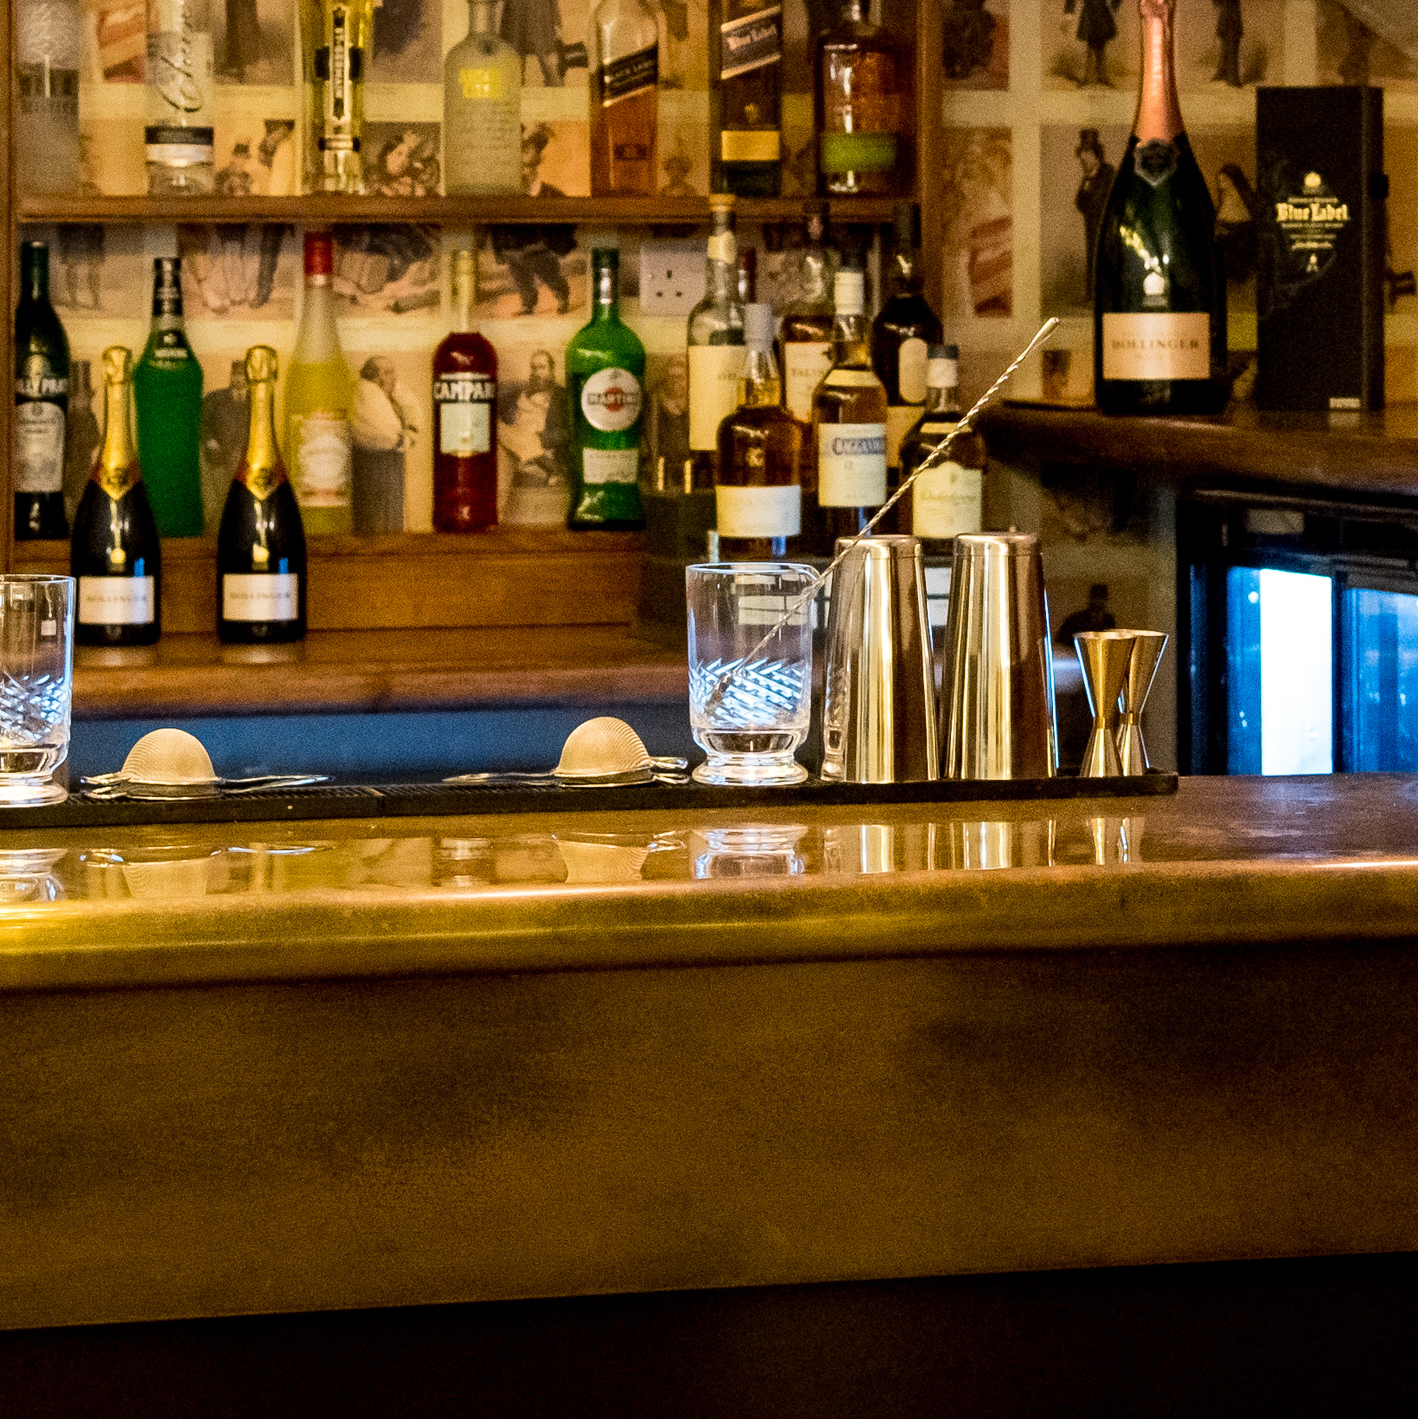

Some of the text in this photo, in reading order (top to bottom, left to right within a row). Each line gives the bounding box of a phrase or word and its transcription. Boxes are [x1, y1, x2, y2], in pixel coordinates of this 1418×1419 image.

[1275, 202, 1348, 222] Blue Label
[1111, 339, 1200, 350] BOLLINGER
